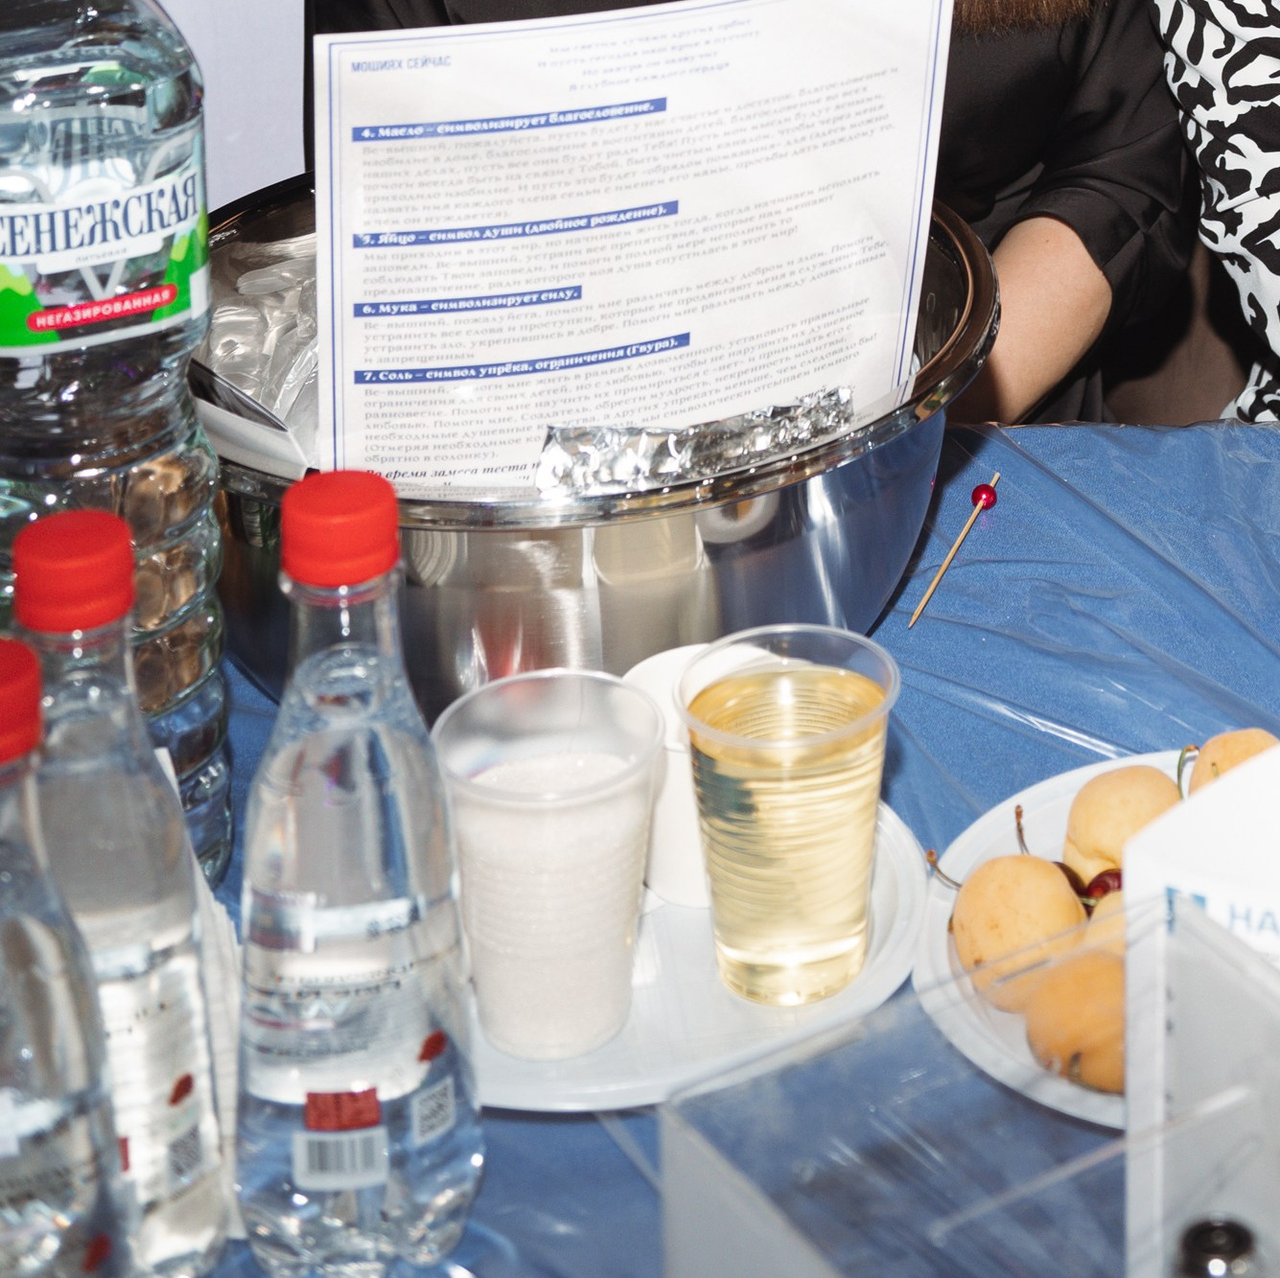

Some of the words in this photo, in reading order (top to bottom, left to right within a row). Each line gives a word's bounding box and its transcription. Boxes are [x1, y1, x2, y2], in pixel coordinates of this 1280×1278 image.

[351, 57, 403, 73] МОШИЯХ
[407, 55, 451, 70] СЕЙЧАС
[379, 127, 423, 136] Масло
[436, 116, 546, 133] символизирует
[549, 102, 654, 123] благословение.
[0, 172, 199, 258] ЕНЕЖСКАЯ
[378, 234, 415, 243] Яйцо
[429, 230, 479, 240] символ
[483, 226, 522, 237] души
[525, 218, 587, 233] (двойное
[590, 206, 667, 226] рождение).
[35, 289, 171, 328] НЕГАЗИРОВАННАЯ
[362, 305, 374, 314] 6.
[379, 303, 416, 313] Мука
[431, 293, 538, 309] символизирует
[540, 288, 578, 299] силу.
[364, 372, 375, 381] 7.
[379, 371, 412, 380] Соль
[426, 366, 475, 377] символ
[480, 361, 532, 375] упрёка,
[535, 347, 623, 367] ограничения
[626, 338, 678, 355] (Гвура).
